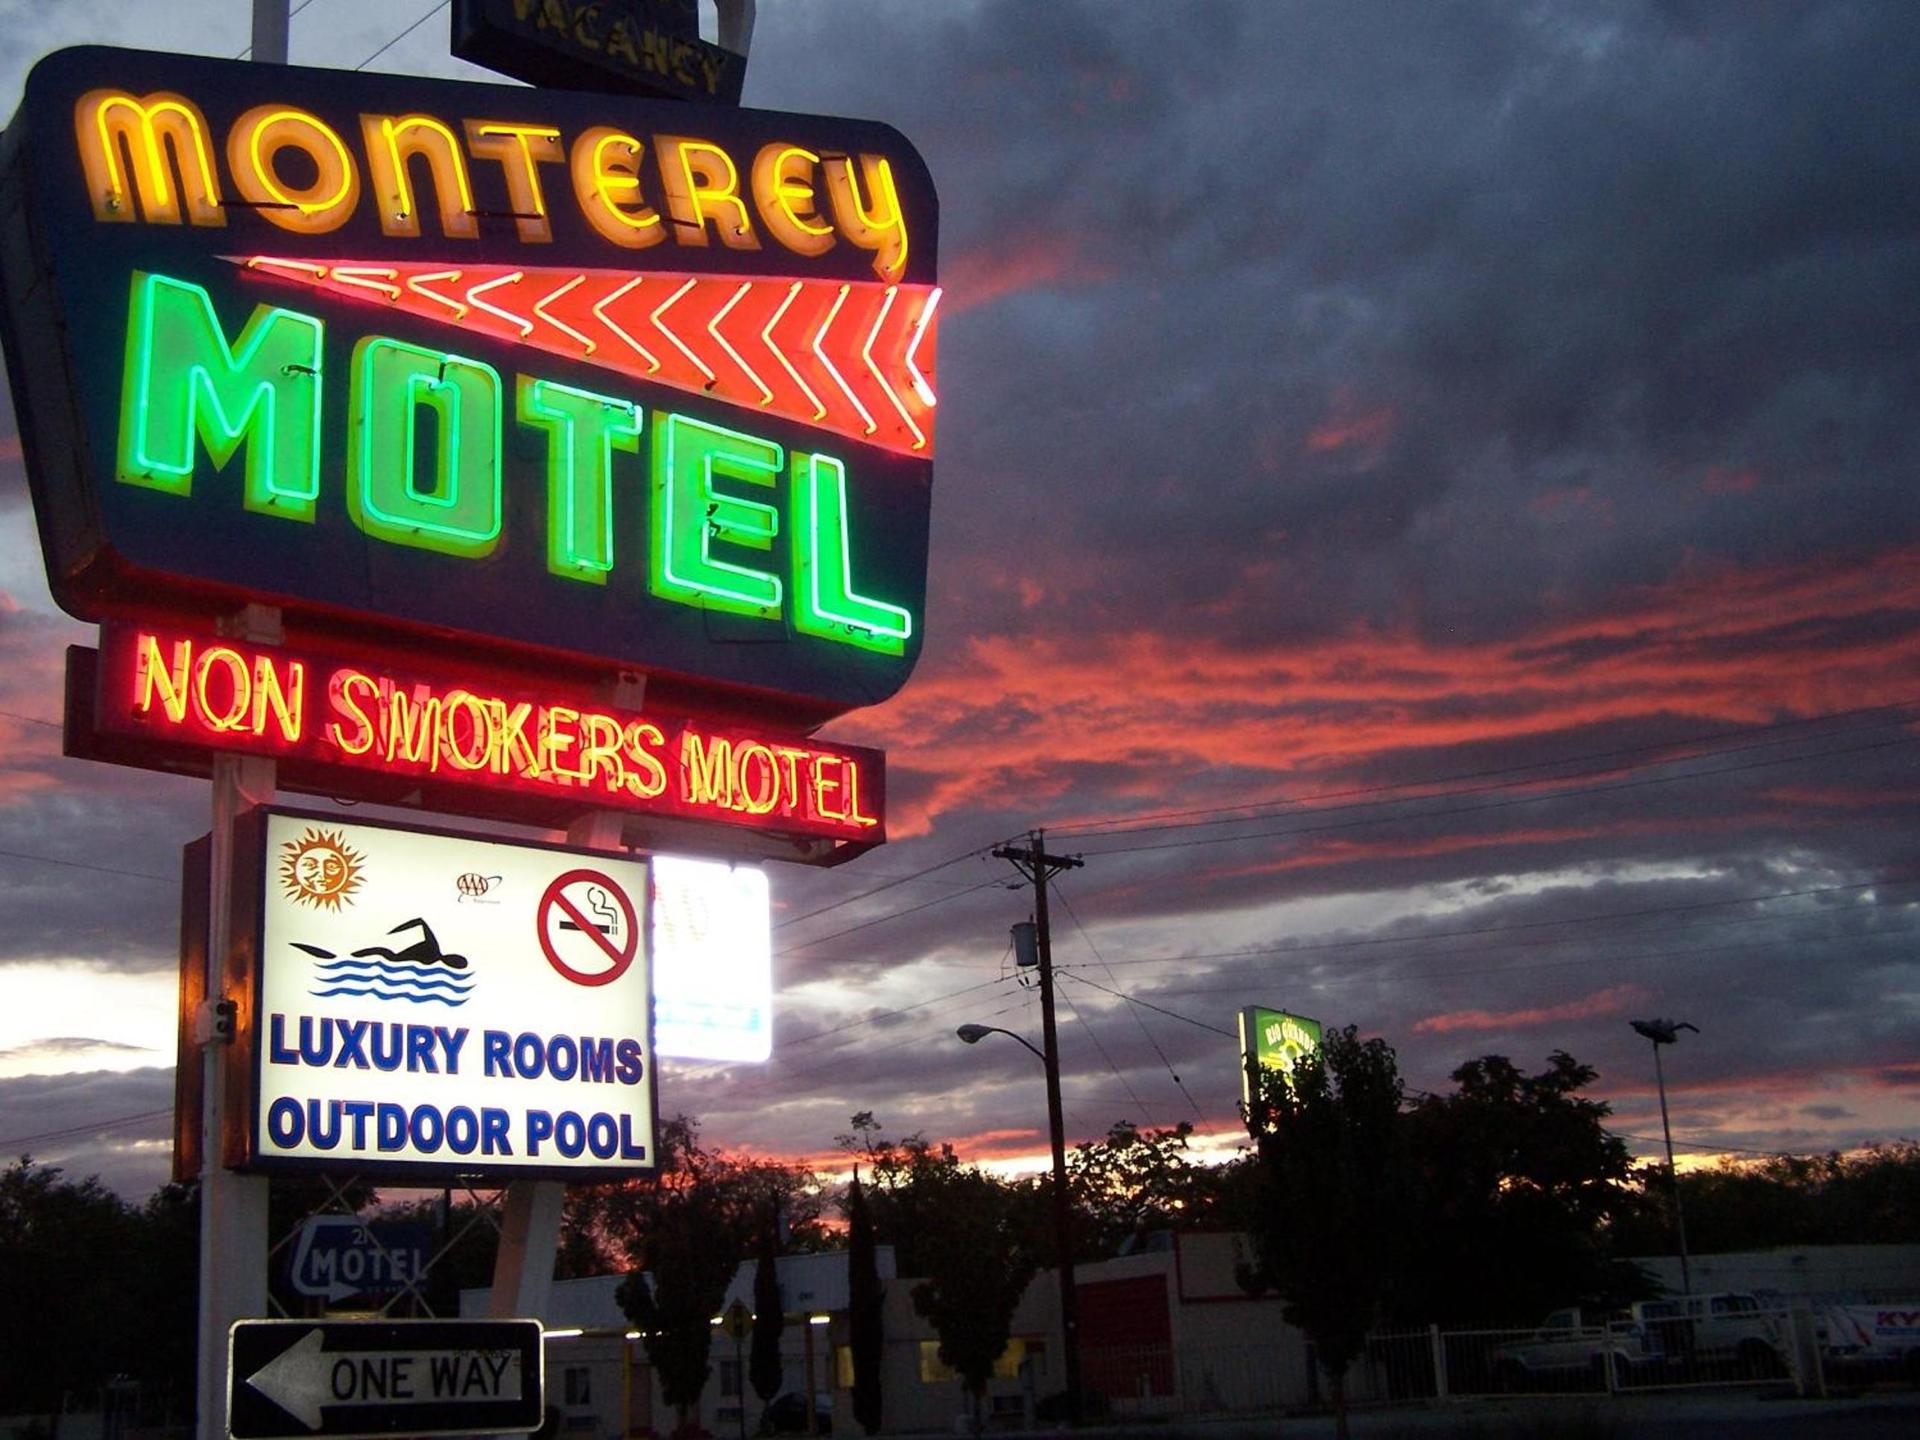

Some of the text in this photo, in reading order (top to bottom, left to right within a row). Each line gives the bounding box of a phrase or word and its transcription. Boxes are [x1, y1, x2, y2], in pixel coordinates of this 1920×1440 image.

[74, 89, 908, 283] MONTEREY
[115, 270, 914, 656] MOTEL
[135, 634, 878, 827] NON SMOKERS MOTEL
[270, 1013, 643, 1086] LUXURY ROOMS
[267, 1096, 646, 1160] OUTDOOR POOL
[310, 1248, 428, 1281] MOTEL
[330, 1355, 512, 1400] ONE WAY
